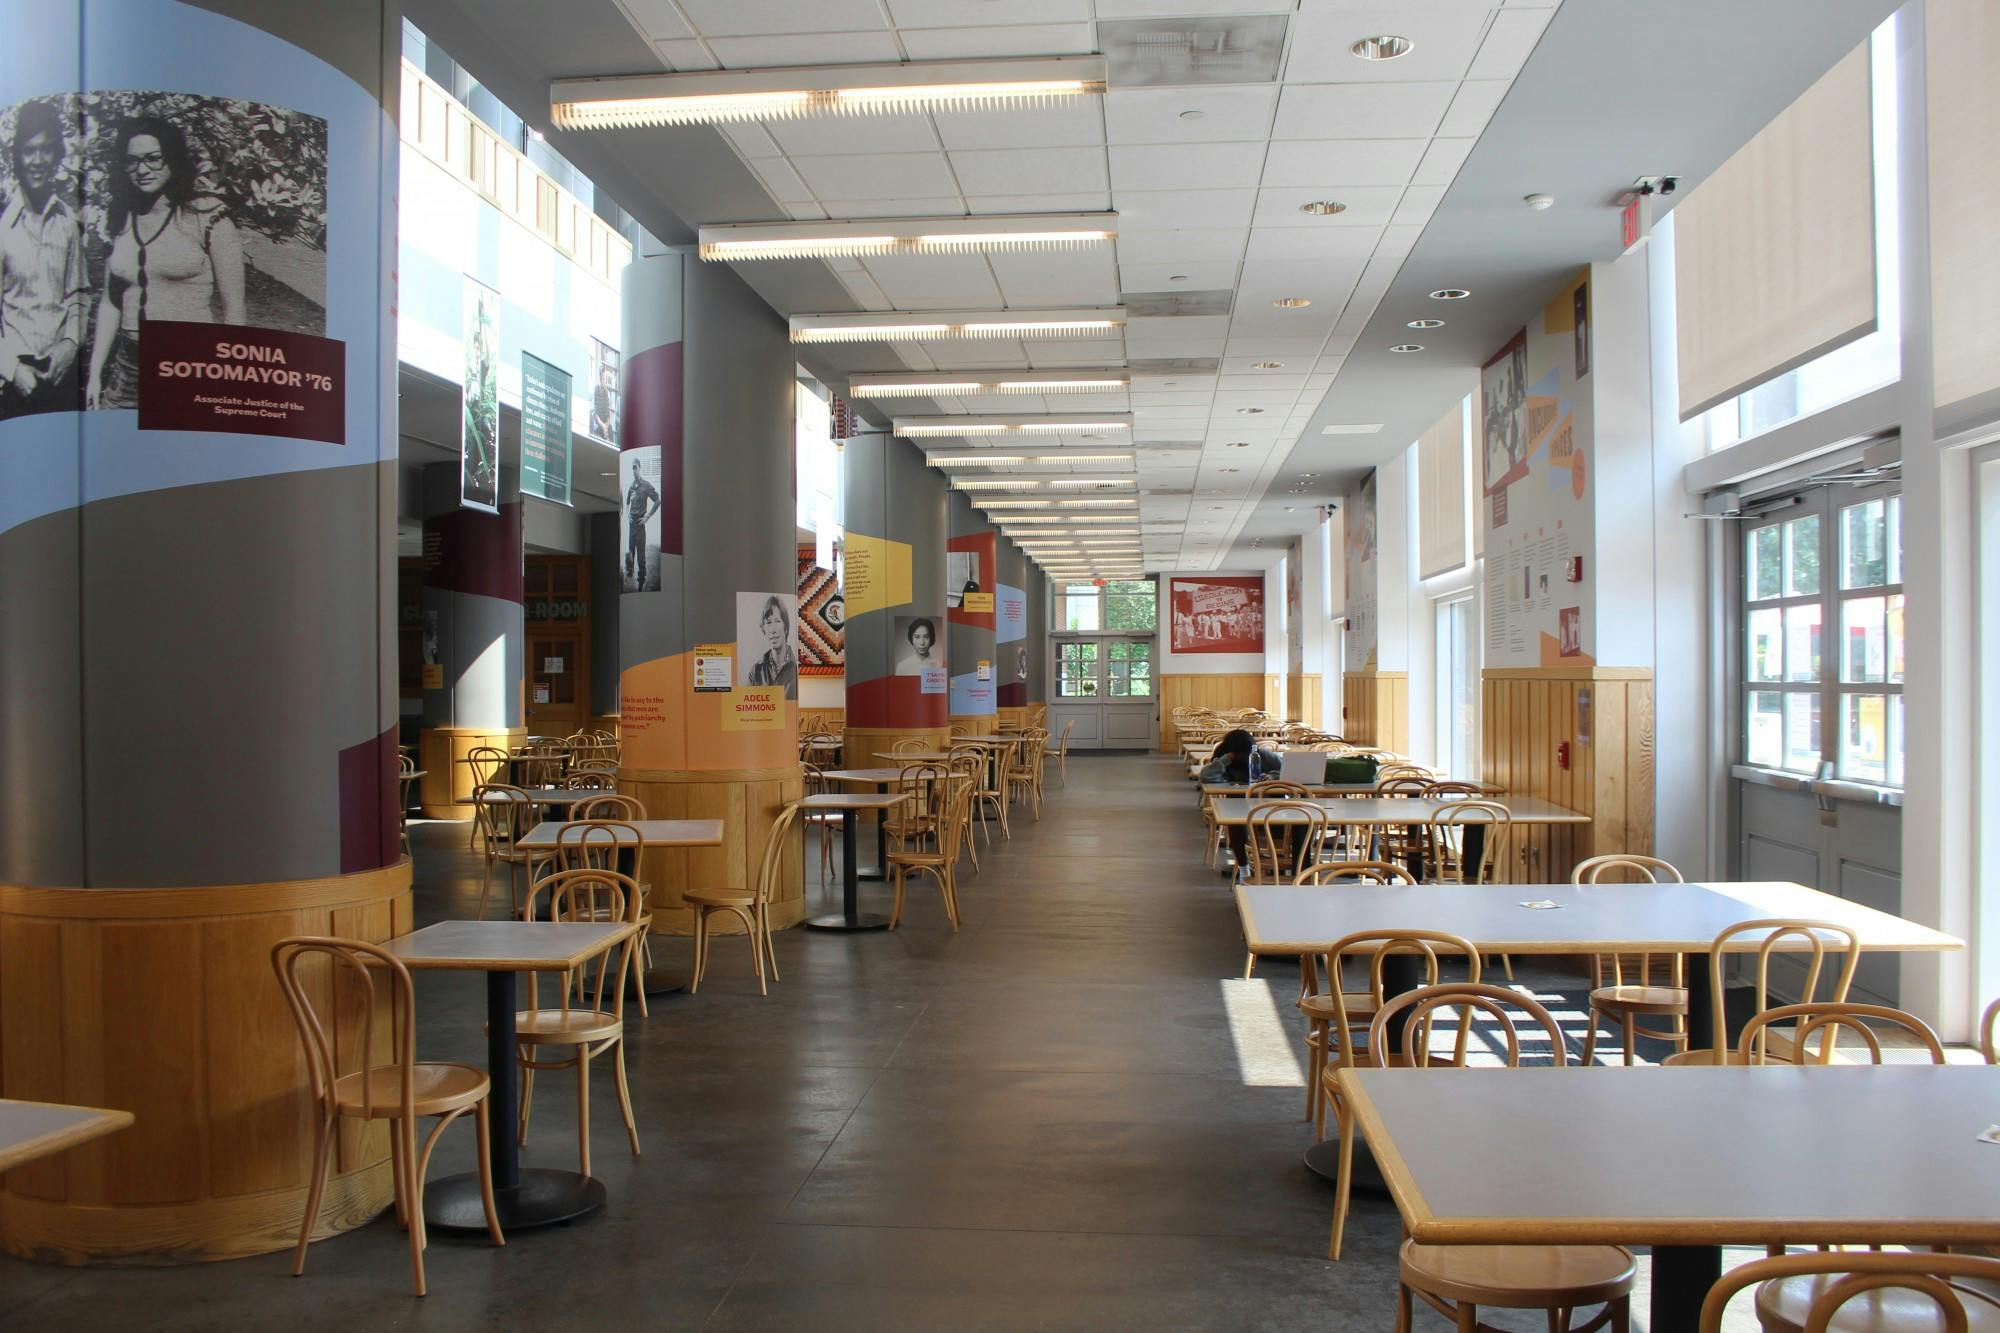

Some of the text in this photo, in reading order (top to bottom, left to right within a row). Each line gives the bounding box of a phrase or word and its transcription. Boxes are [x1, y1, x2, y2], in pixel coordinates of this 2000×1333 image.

[215, 342, 286, 365] SONIA
[158, 361, 332, 391] SOTOMAYOR '76
[194, 394, 304, 412] Associate Justice of the
[214, 405, 287, 419] Supreme Court
[744, 694, 771, 702] ADELE
[735, 703, 776, 711] SIMMONS
